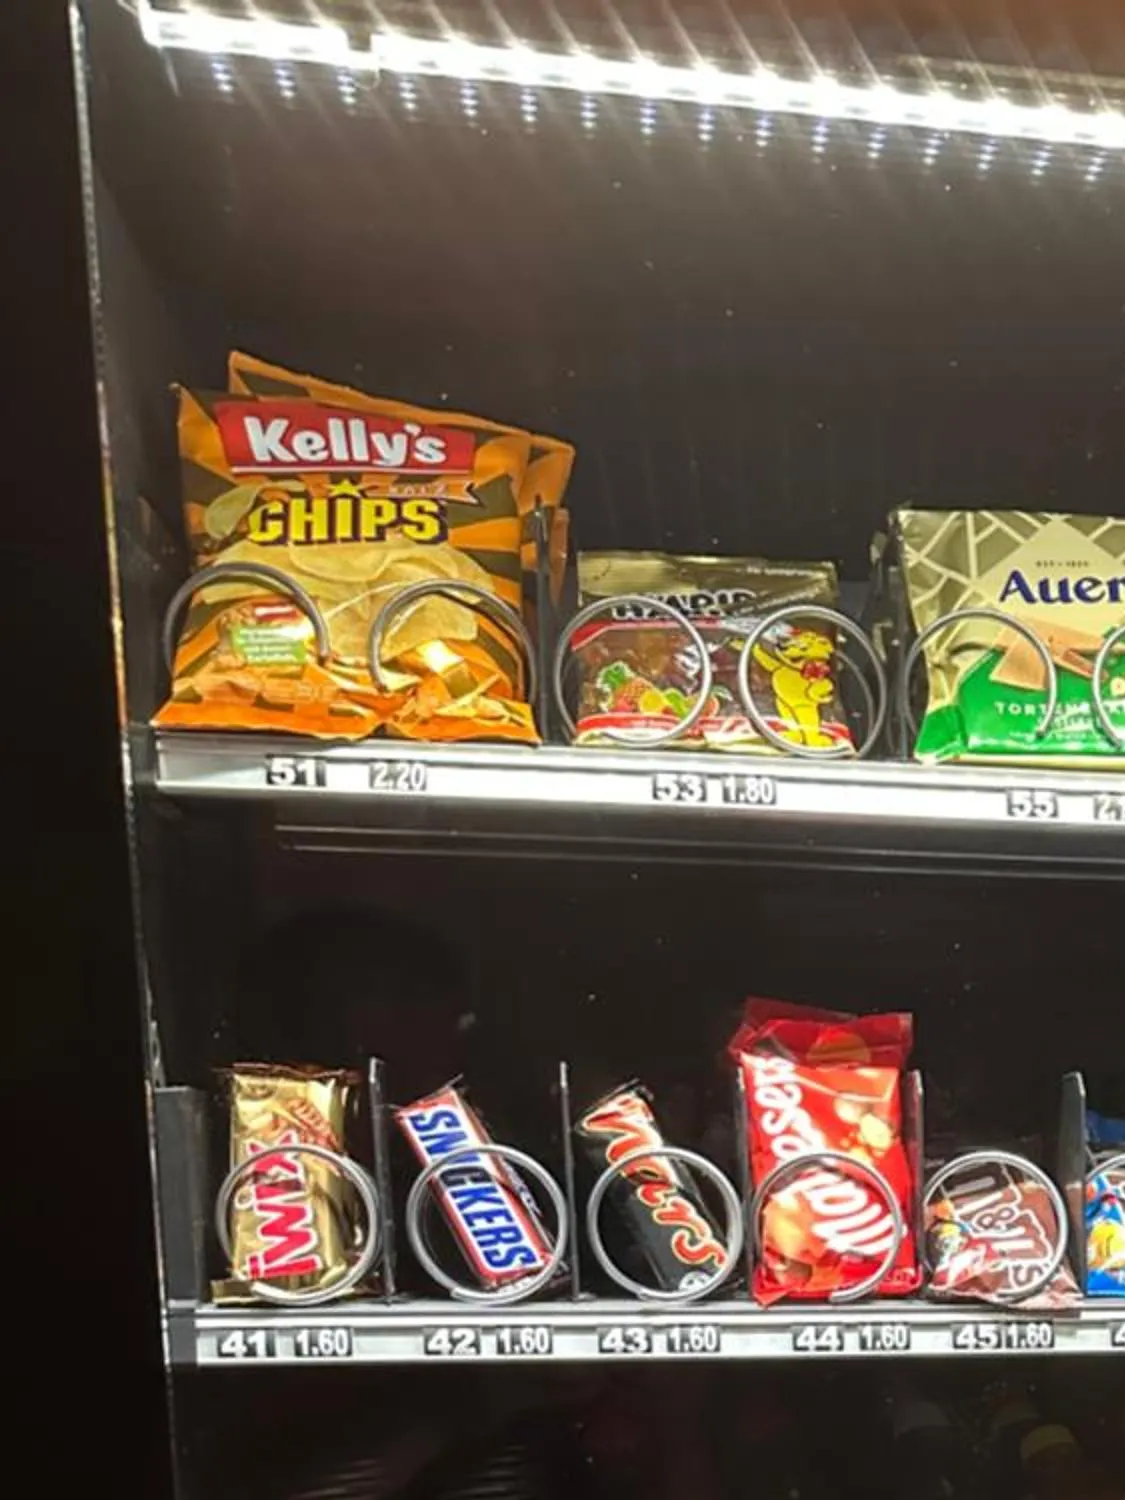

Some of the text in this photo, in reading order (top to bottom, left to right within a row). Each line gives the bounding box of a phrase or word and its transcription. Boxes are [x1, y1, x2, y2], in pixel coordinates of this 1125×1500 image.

[244, 416, 447, 466] Kelly's
[248, 498, 444, 545] CHIPS
[270, 757, 426, 789] 51 2.20
[656, 775, 775, 803] 53 1.80
[1011, 791, 1055, 818] 55
[407, 1108, 537, 1270] SNICKERS
[221, 1329, 350, 1357] 41 1.60
[427, 1326, 550, 1355] 42 1.60
[601, 1326, 718, 1353] 43 1.60
[795, 1324, 908, 1351] 44 1.60
[956, 1322, 1052, 1349] 45 1.60
